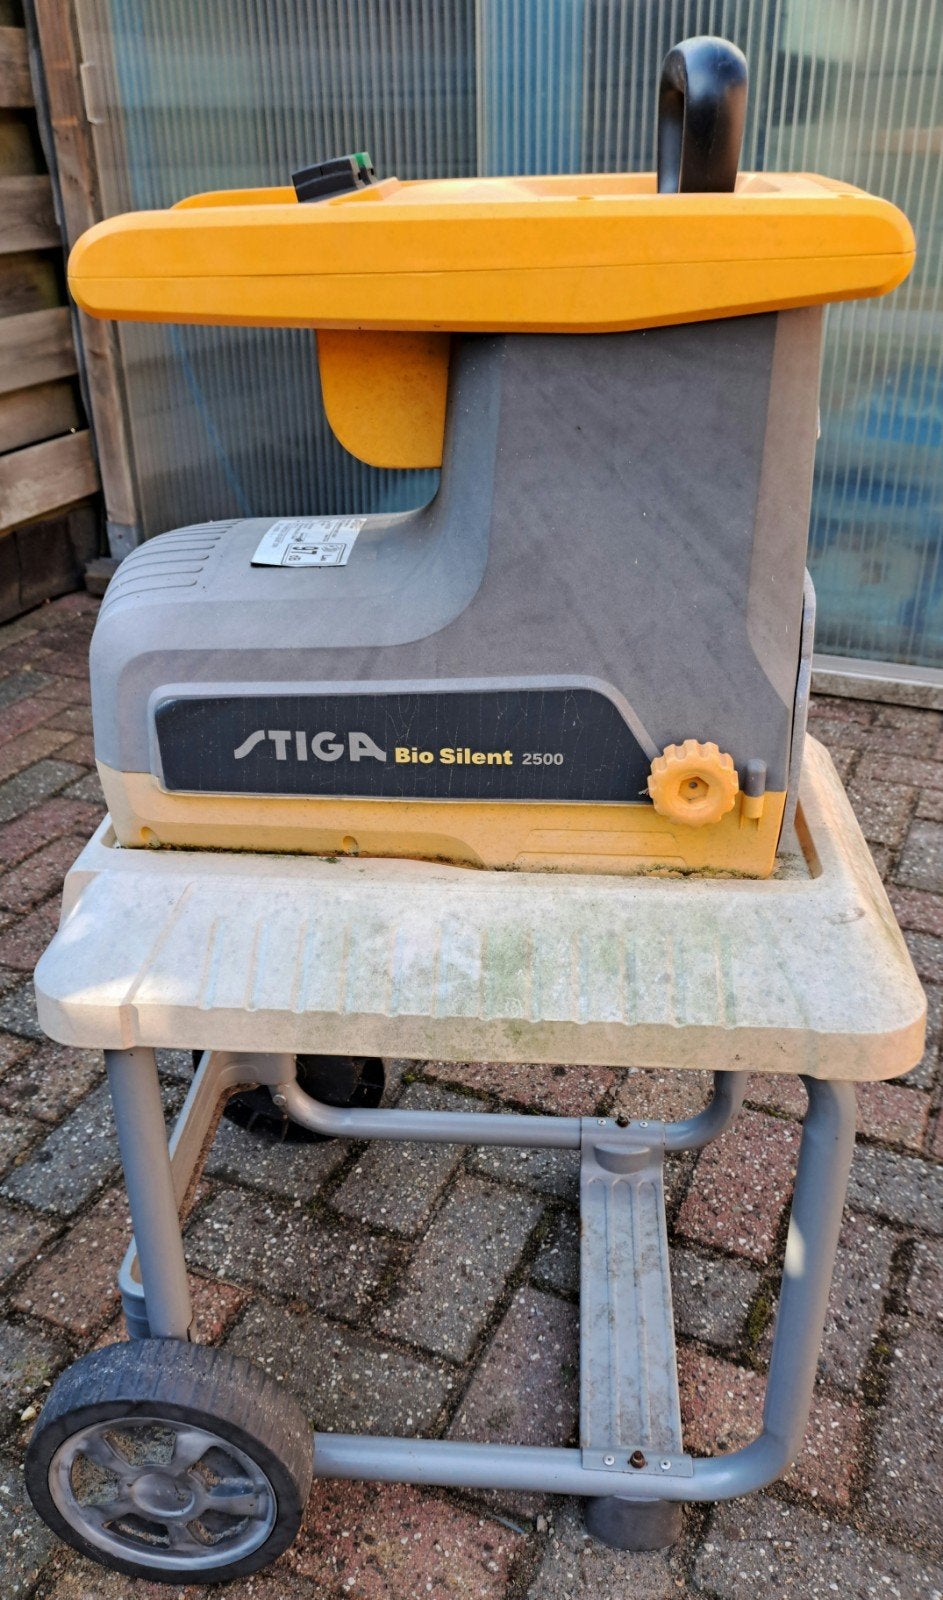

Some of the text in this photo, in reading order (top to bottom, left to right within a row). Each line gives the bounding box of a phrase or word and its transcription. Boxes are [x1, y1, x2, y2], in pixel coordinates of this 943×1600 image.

[234, 730, 564, 766] STIGA Bio Silent 2500
